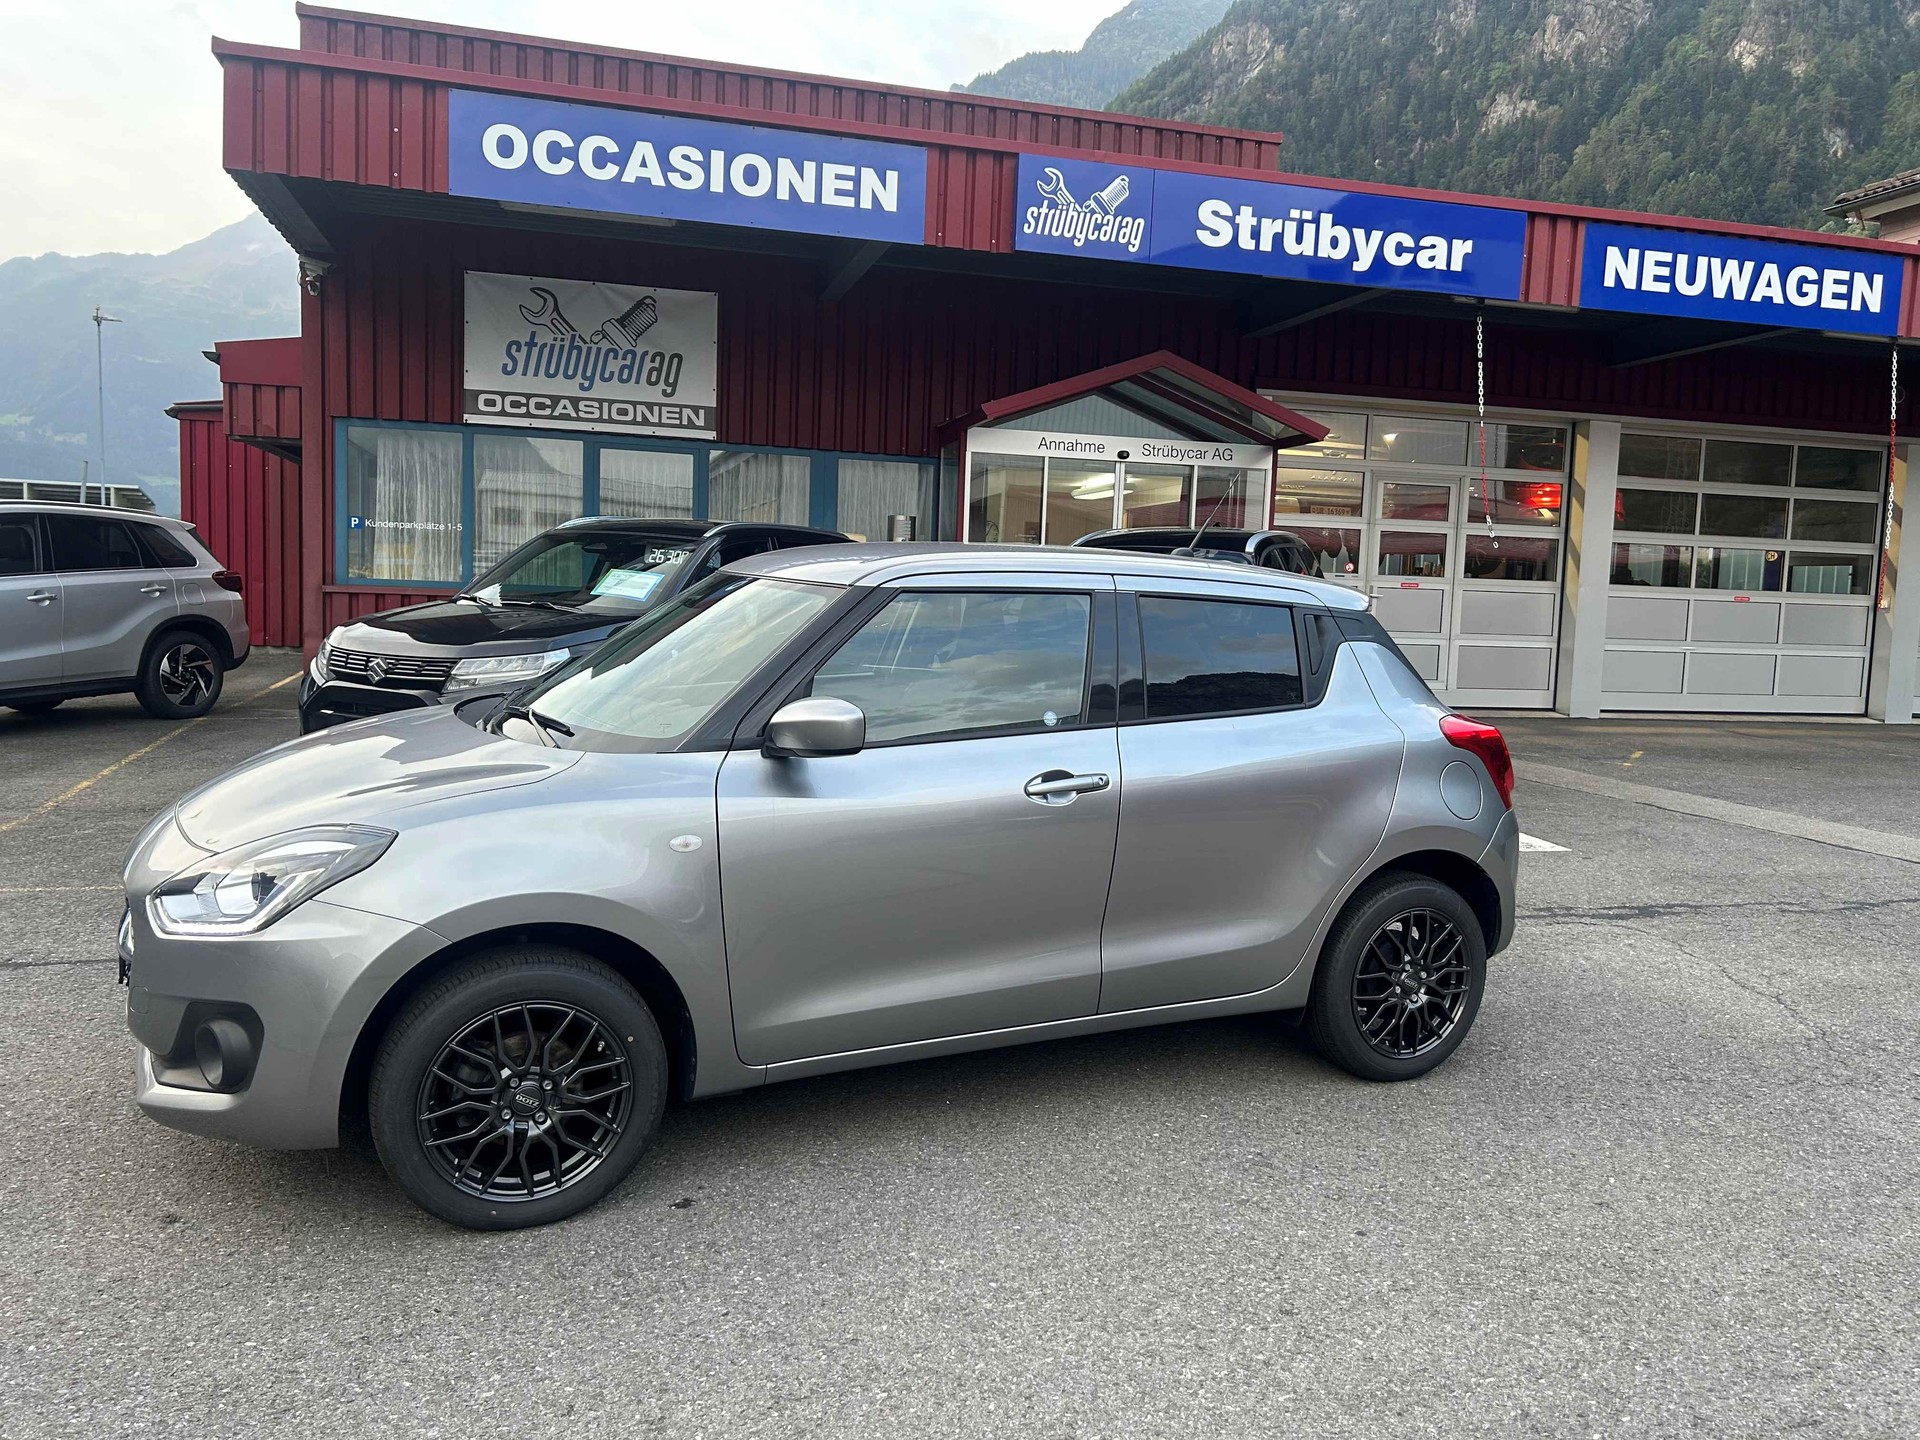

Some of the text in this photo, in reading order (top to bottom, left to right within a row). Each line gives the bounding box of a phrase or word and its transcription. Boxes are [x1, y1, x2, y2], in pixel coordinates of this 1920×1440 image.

[481, 122, 899, 212] OCCASIONEN
[1023, 200, 1145, 252] strübycarag
[1196, 199, 1473, 272] Strübycar
[1603, 245, 1884, 313] NEUWAGEN
[477, 393, 705, 427] OCCASIONEN
[1038, 436, 1105, 453] Annahme
[1141, 443, 1233, 461] Strübycar AG
[351, 517, 359, 528] P
[365, 519, 445, 530] Kundenparkplätze
[515, 1094, 540, 1108] DOTZ
